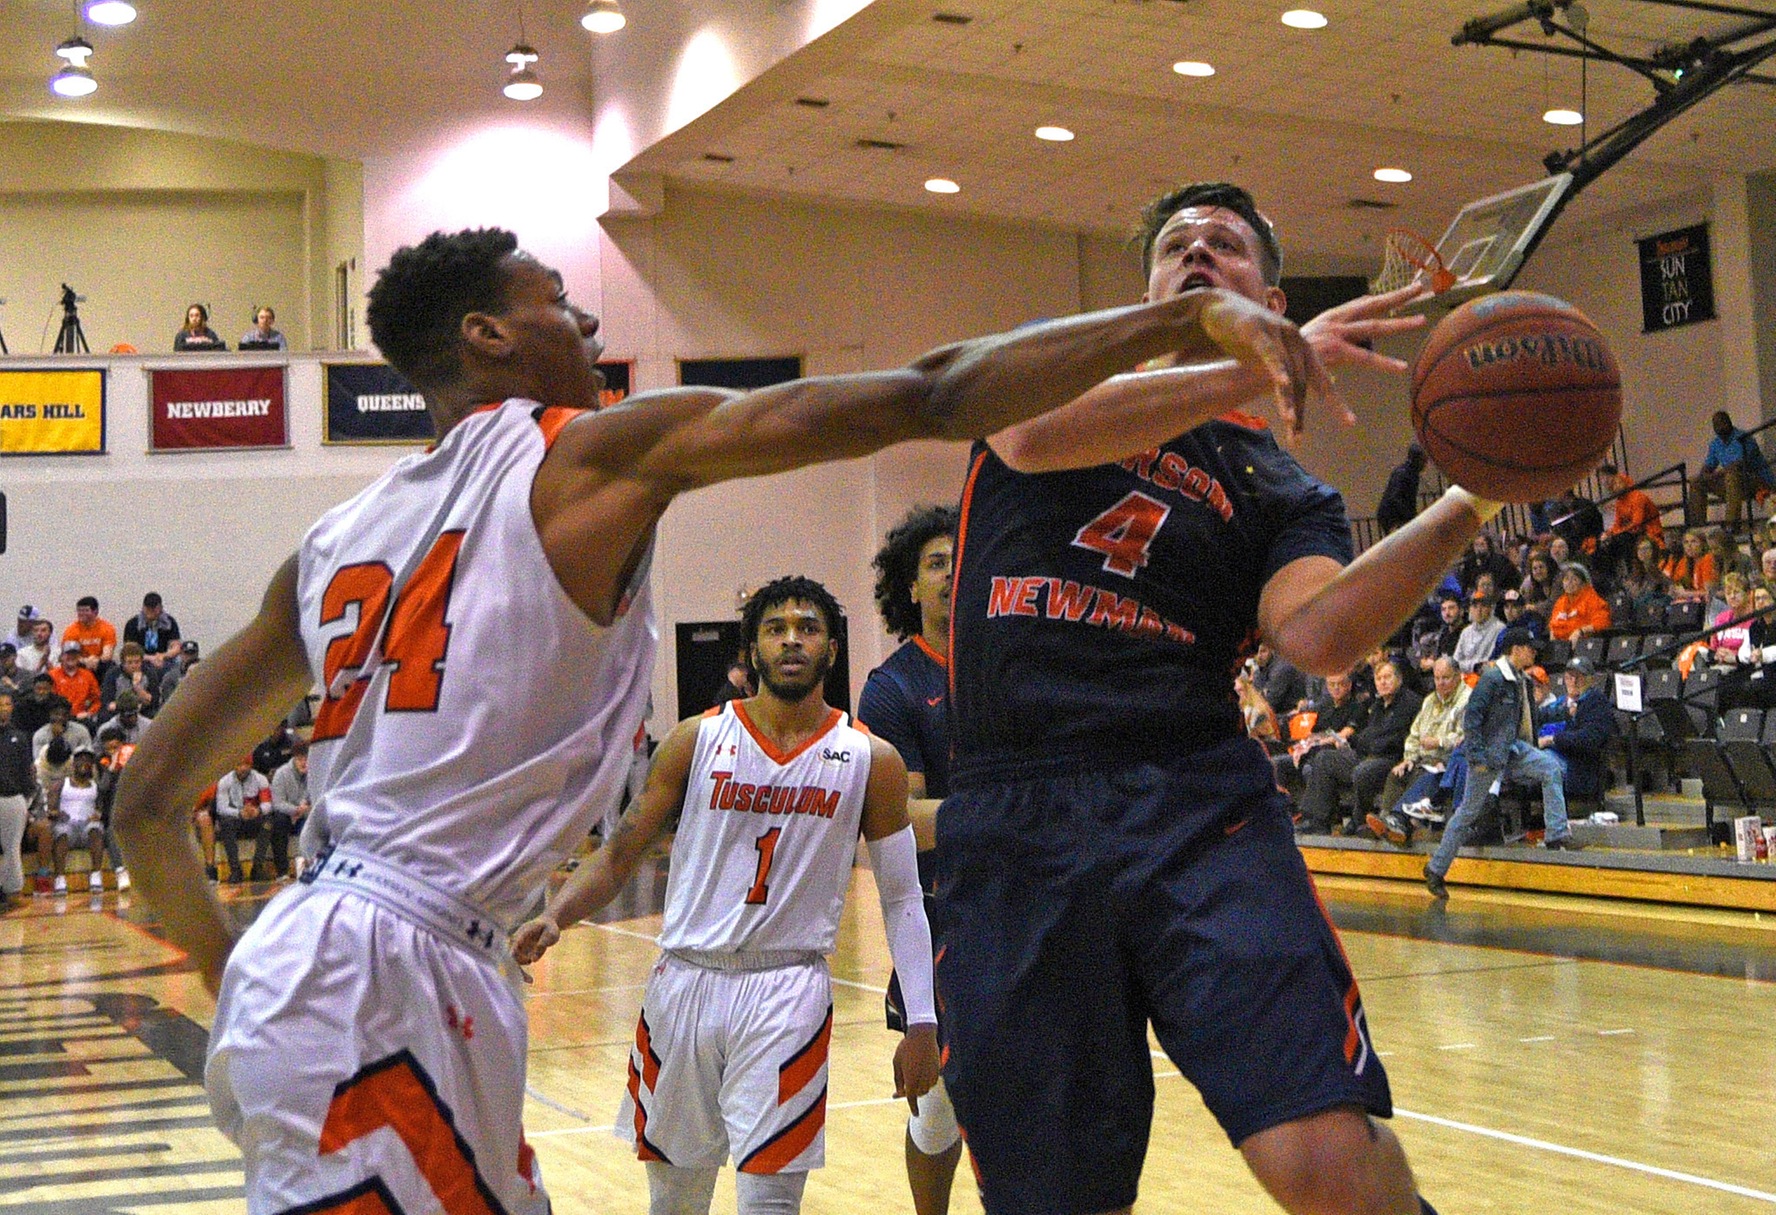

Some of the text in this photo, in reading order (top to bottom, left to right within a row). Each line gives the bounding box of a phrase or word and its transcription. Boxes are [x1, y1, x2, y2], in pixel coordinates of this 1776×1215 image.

[1660, 255, 1686, 281] SUN
[1663, 279, 1689, 301] TAN
[1662, 300, 1692, 325] CITY
[0, 404, 86, 419] ARS HILL
[166, 399, 271, 419] NEWBERRY
[357, 393, 427, 413] QUEENS
[1119, 448, 1234, 523] RSON
[1070, 490, 1171, 580] 4
[311, 528, 467, 743] 24
[823, 747, 851, 763] SAC
[709, 770, 842, 820] TUSCULUM
[744, 826, 782, 905] 1
